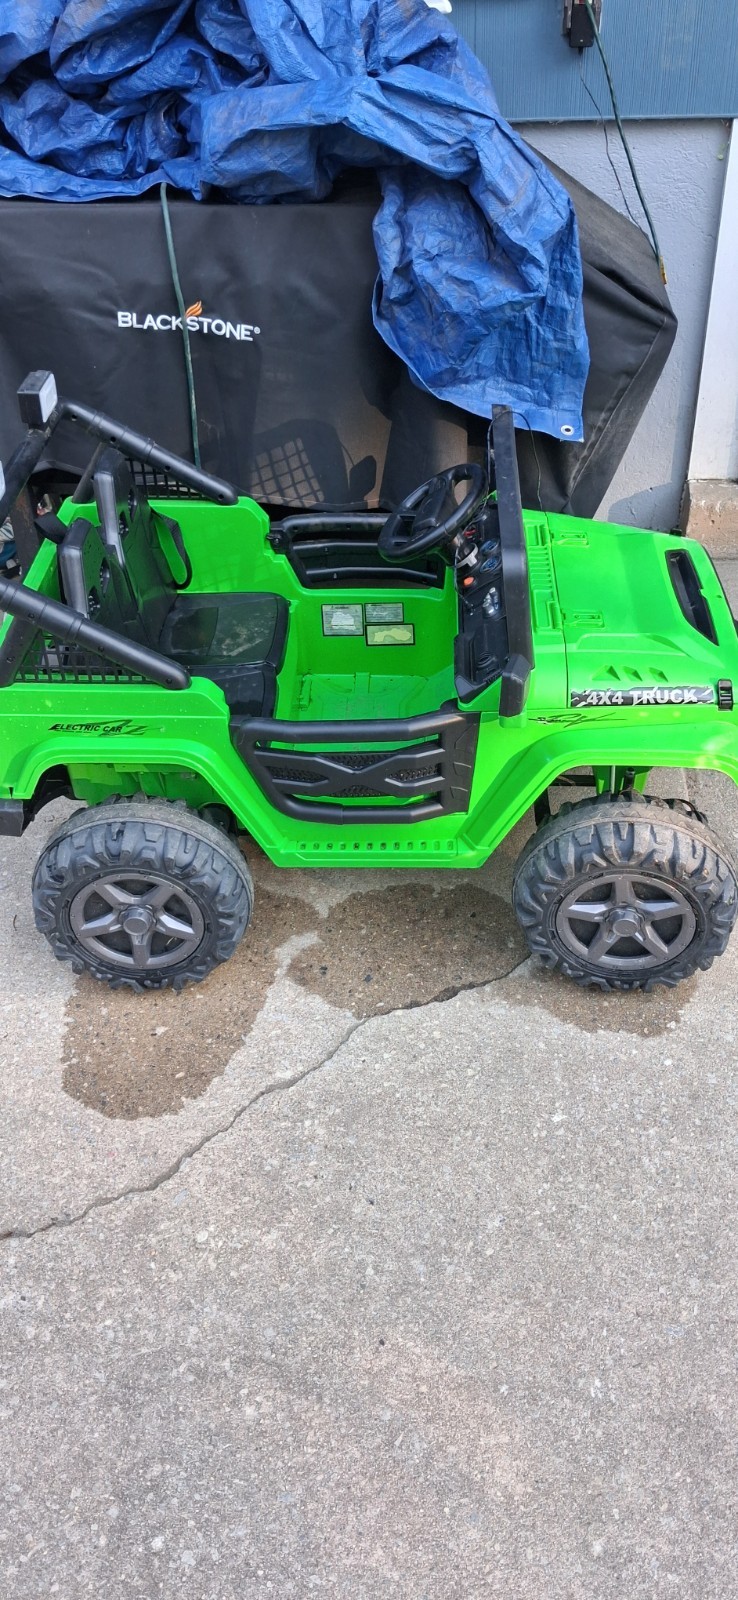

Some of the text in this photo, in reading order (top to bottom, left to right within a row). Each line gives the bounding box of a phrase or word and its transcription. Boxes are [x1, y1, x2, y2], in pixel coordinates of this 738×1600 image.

[586, 689, 698, 705] 4X4 TRUCK
[49, 723, 123, 733] ELECTRIC CAR
